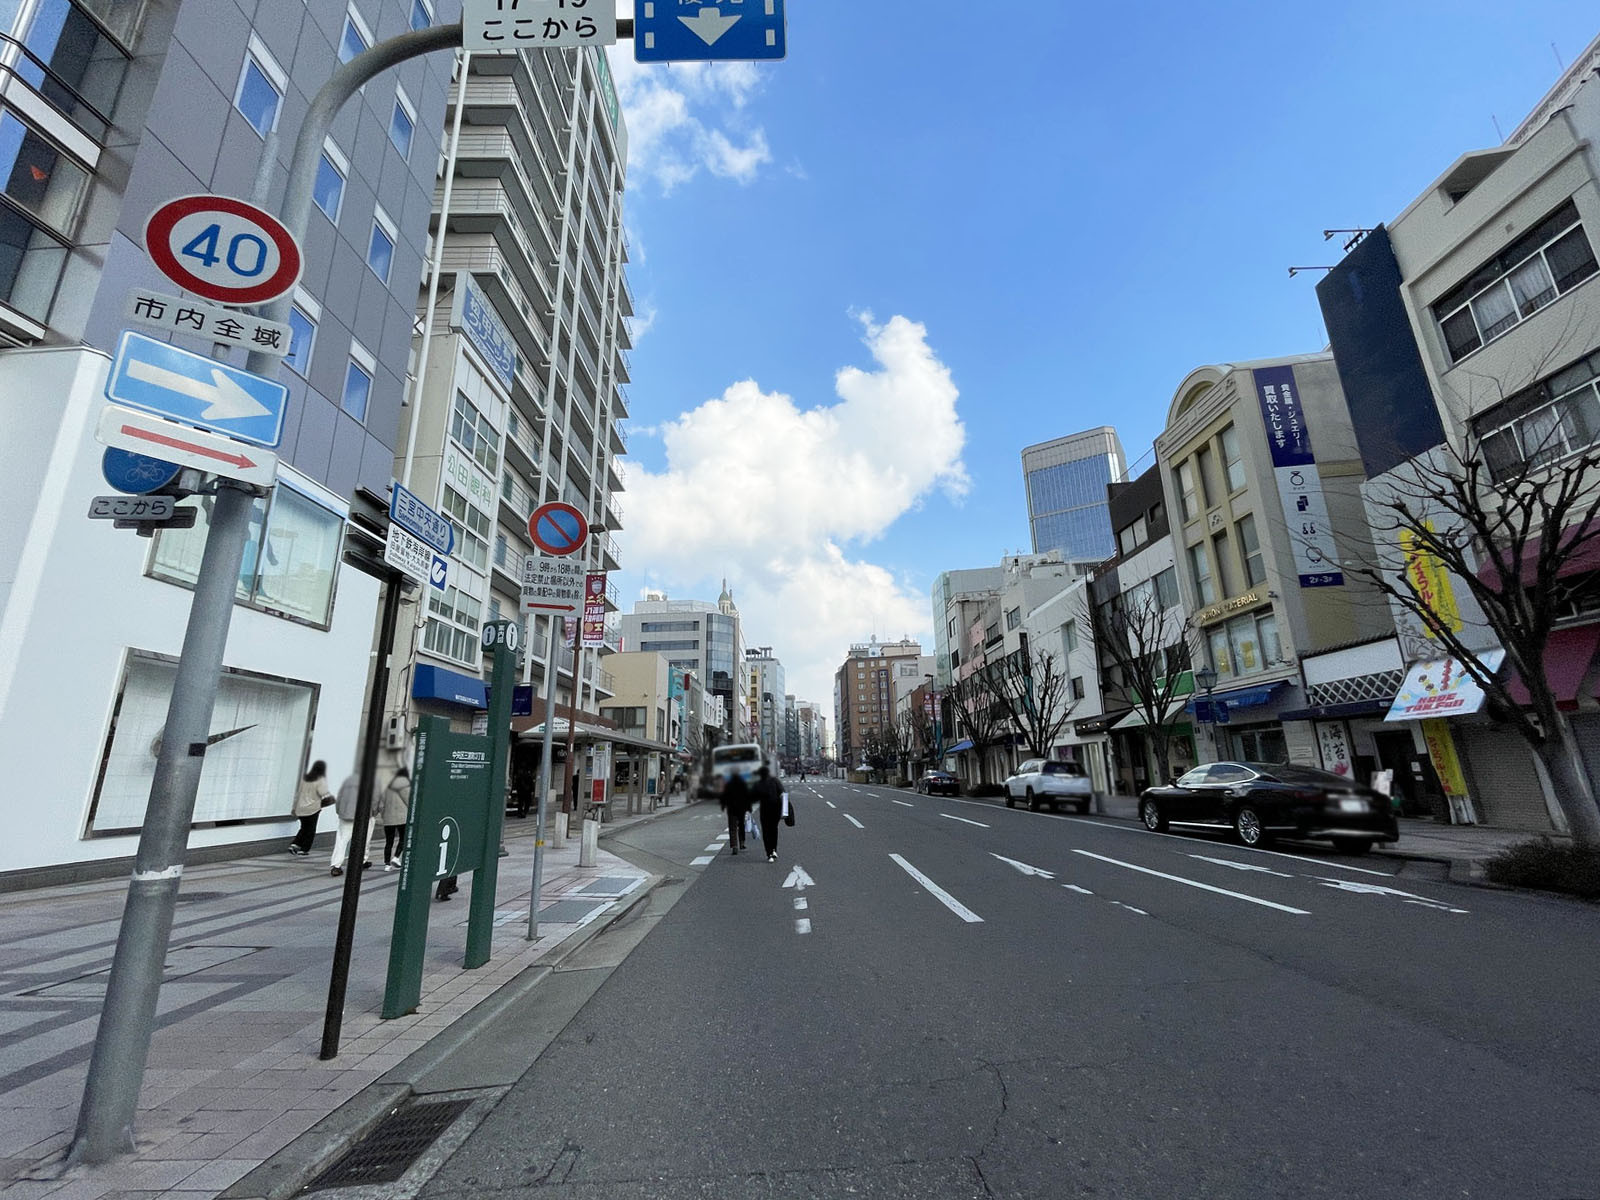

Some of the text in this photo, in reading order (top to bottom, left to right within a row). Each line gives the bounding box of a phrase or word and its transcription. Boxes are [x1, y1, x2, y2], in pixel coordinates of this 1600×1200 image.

[483, 17, 598, 40] ここから
[182, 223, 267, 278] 40
[134, 296, 282, 349] 市内全域
[468, 311, 511, 371] クリニック
[1263, 385, 1286, 448] 買取いたします
[94, 500, 167, 515] ここから
[399, 492, 446, 538] 三宮中央通り
[391, 528, 430, 561] 地下鉄海岸線
[1329, 724, 1345, 760] 海苔
